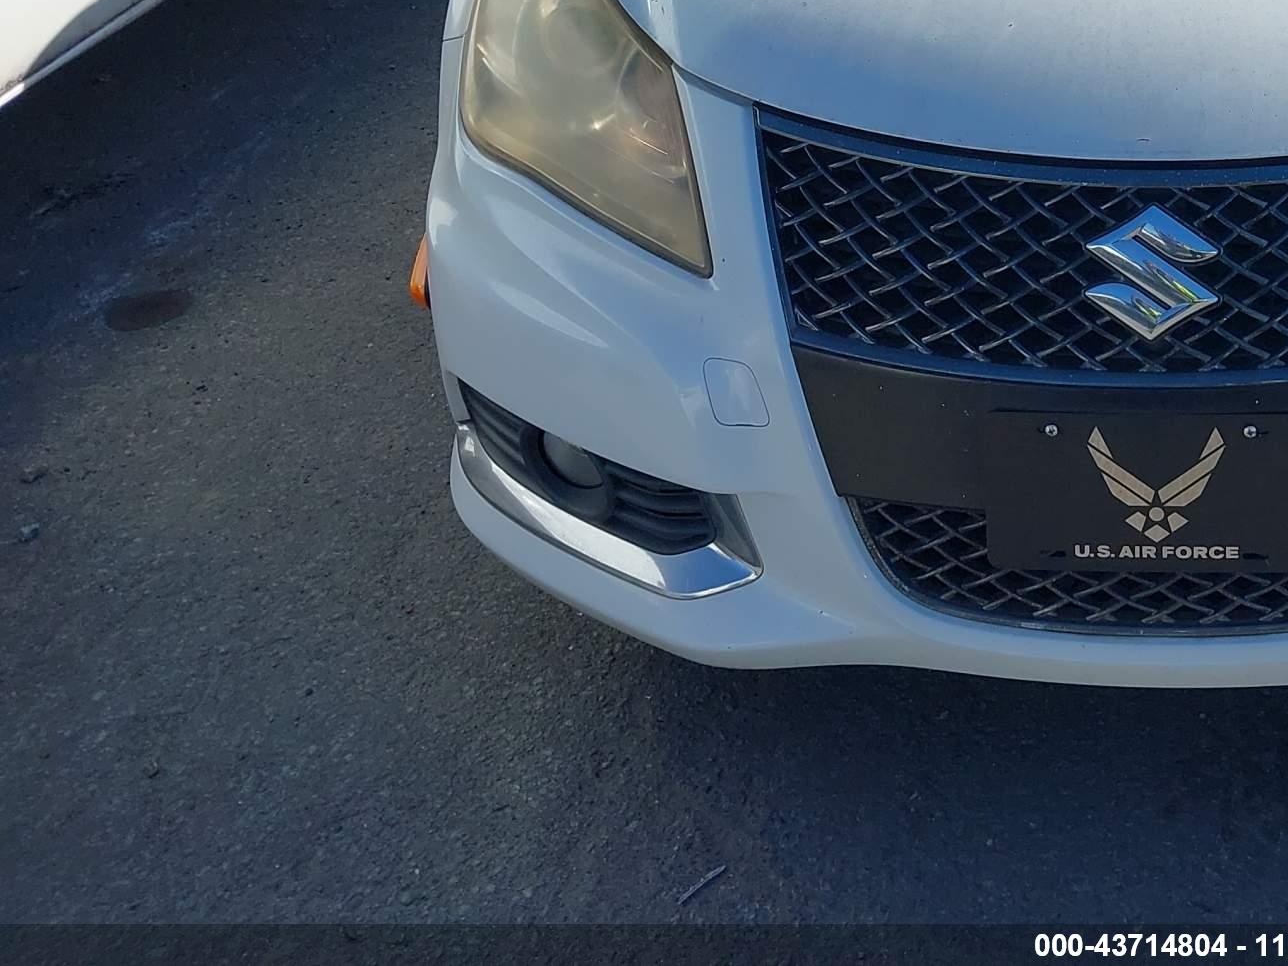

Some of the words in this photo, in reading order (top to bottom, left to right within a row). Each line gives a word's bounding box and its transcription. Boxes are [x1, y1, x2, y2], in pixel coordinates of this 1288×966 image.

[1074, 544, 1115, 558] U.S.
[1119, 545, 1156, 559] AIR
[1162, 546, 1239, 559] FORCE
